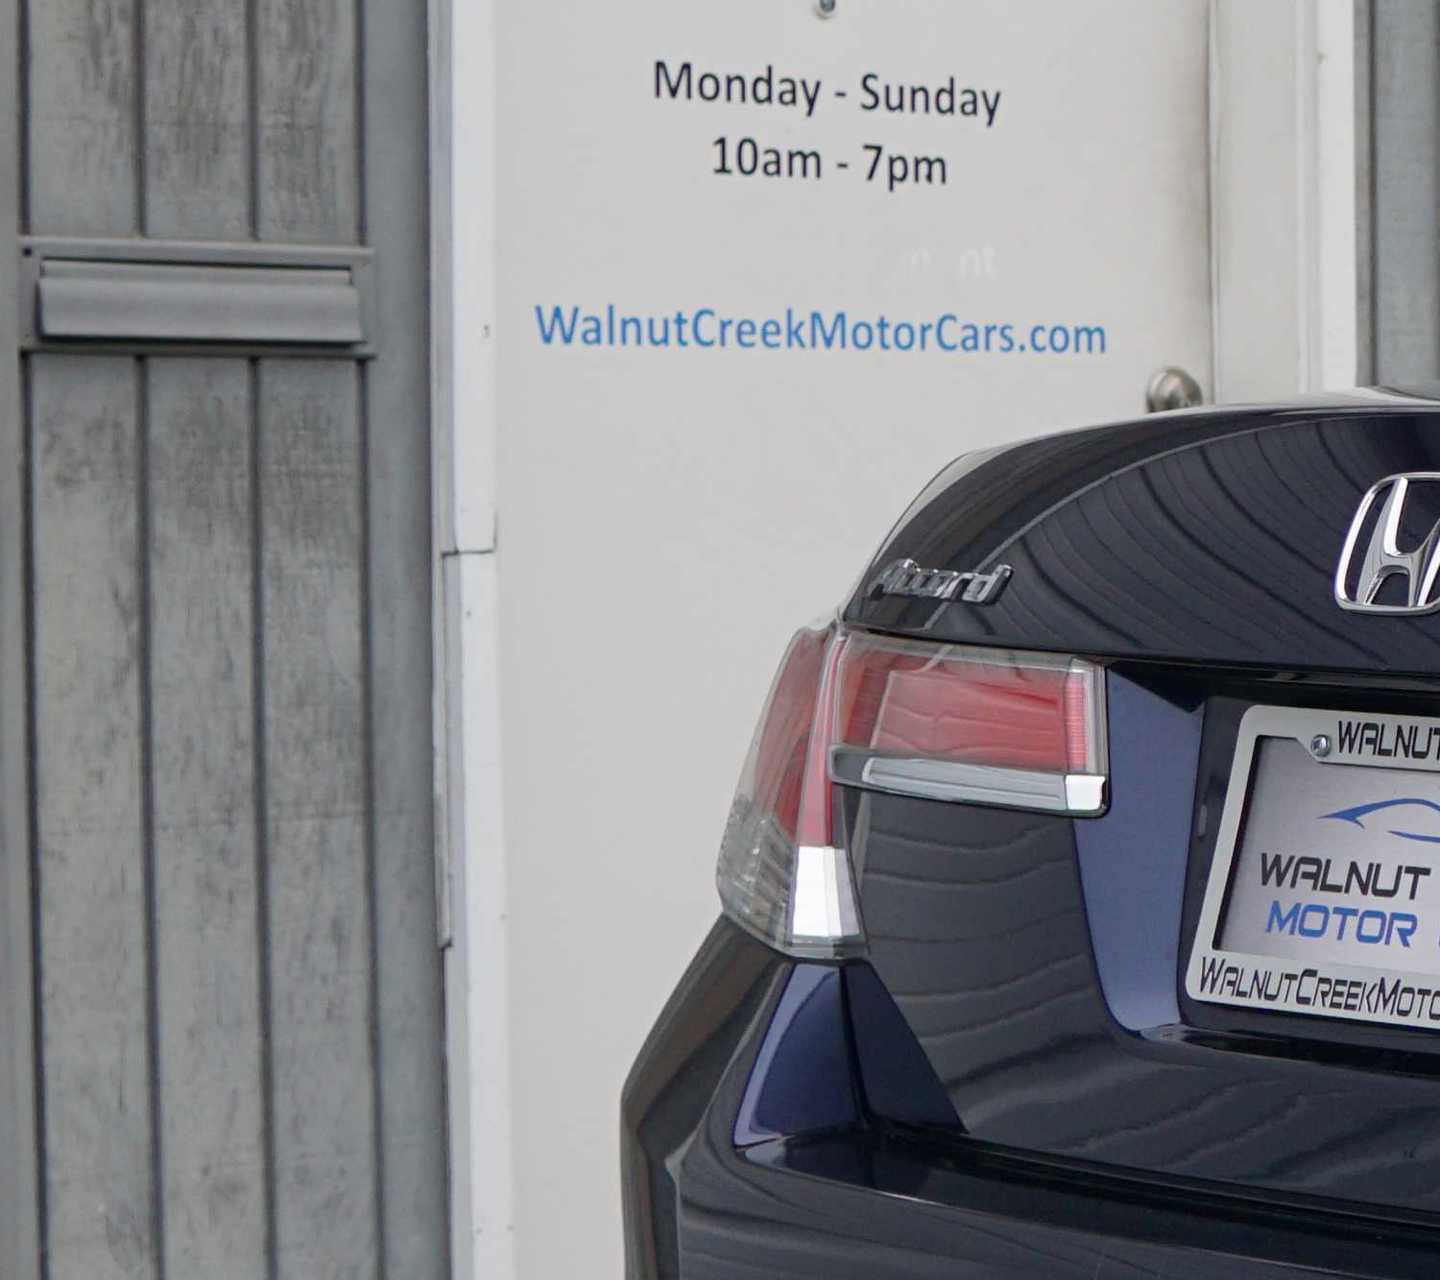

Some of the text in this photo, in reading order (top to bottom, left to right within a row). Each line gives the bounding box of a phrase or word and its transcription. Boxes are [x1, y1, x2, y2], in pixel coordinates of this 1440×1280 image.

[654, 60, 821, 118] Monday
[860, 73, 1001, 128] Sunday
[713, 136, 822, 180] 10am
[862, 143, 947, 193] 7pm
[534, 303, 1107, 354] WalnutCreekMotorCars.com
[1259, 852, 1432, 902] WALNUT
[1265, 900, 1418, 948] MOTOR
